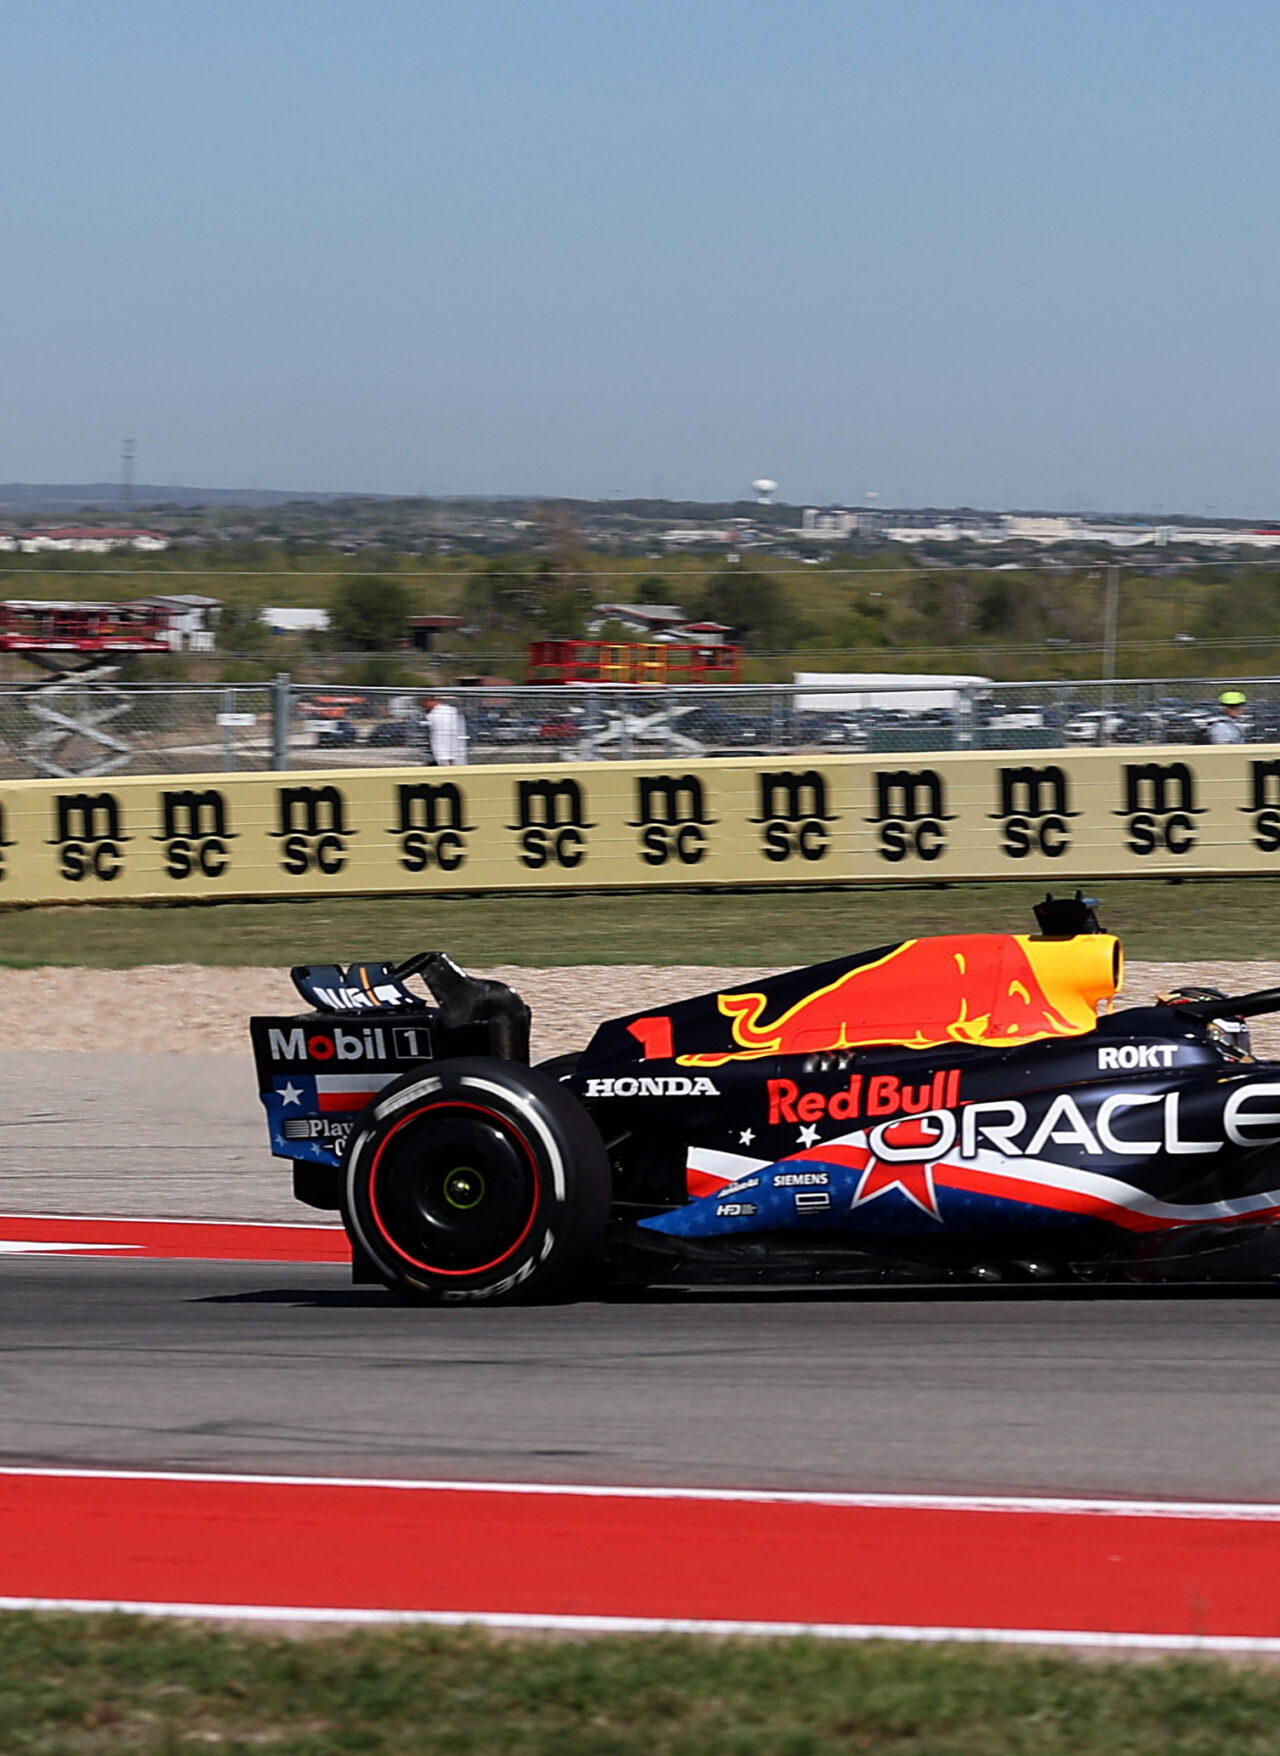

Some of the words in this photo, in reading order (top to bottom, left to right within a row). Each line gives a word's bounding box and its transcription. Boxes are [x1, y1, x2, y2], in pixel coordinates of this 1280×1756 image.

[268, 1028, 387, 1060] Mobil
[403, 1030, 420, 1056] 1
[626, 1016, 676, 1060] 1
[1098, 1045, 1178, 1070] ROKT
[584, 1077, 721, 1097] HONDA
[767, 1074, 861, 1125] Red
[867, 1069, 961, 1117] Bull
[308, 1118, 355, 1138] Play
[773, 1173, 829, 1187] SIEMENS
